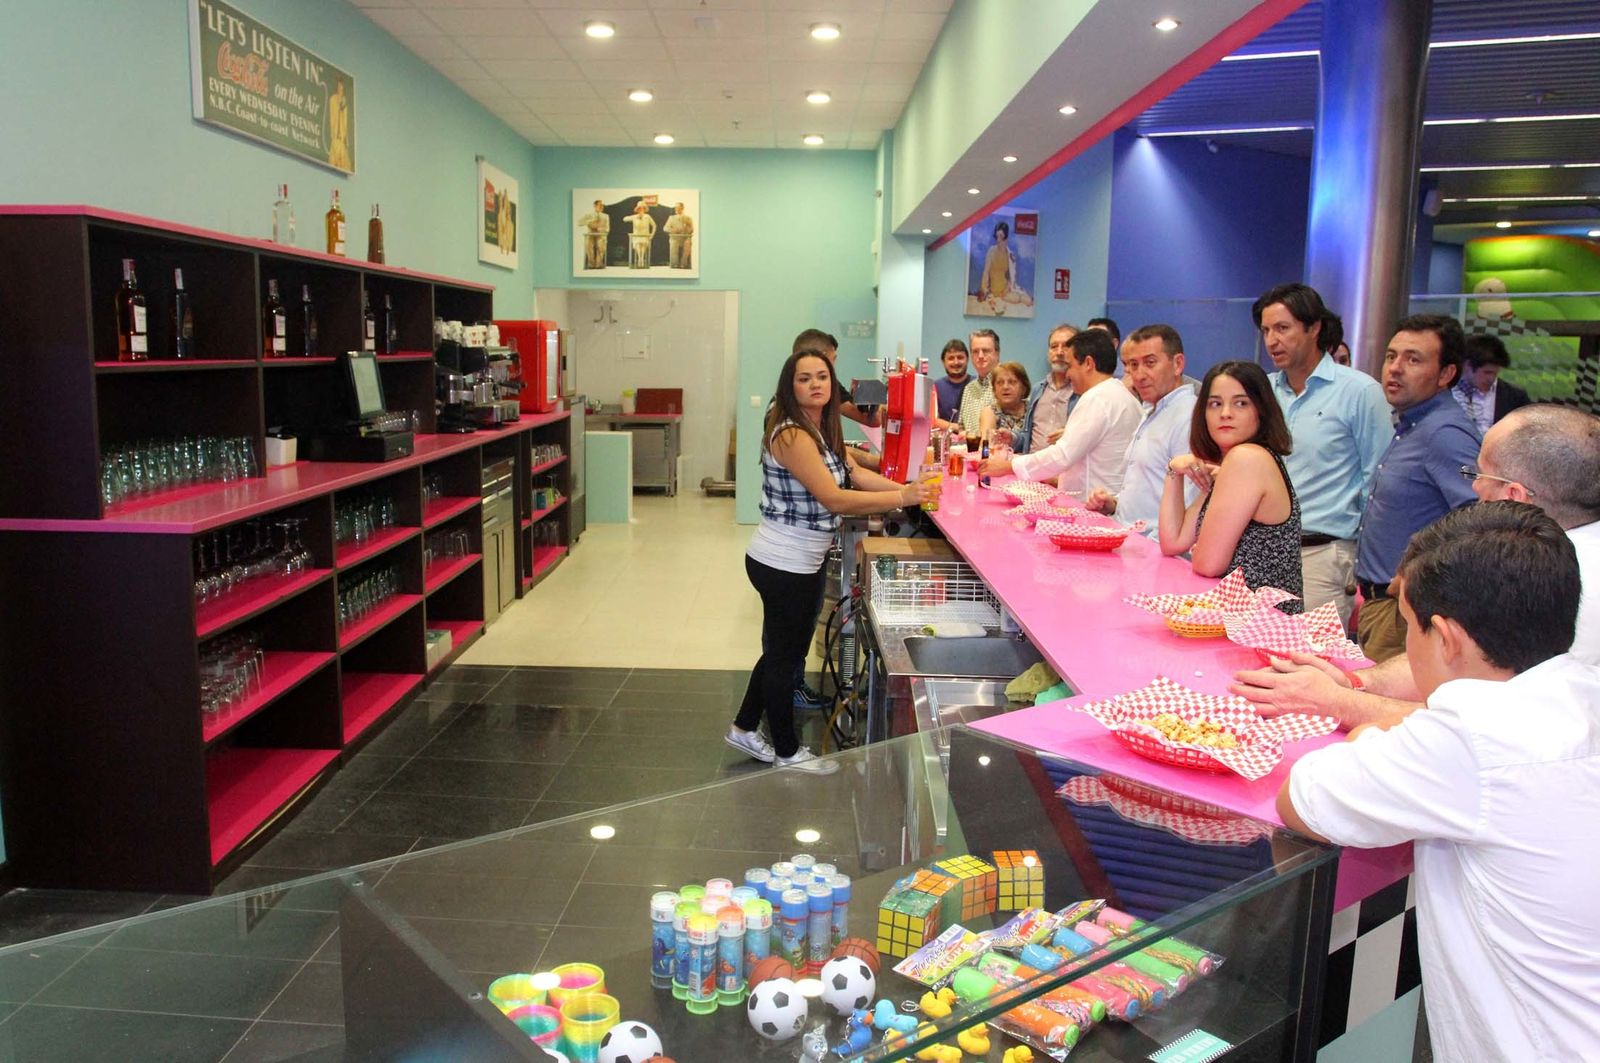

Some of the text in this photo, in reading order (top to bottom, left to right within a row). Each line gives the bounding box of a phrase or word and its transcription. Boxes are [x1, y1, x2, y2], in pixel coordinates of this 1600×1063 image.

[252, 28, 300, 76] LISTEN
[209, 77, 320, 136] EVERY WEDNESDAY EVENING
[274, 84, 320, 116] on the Air
